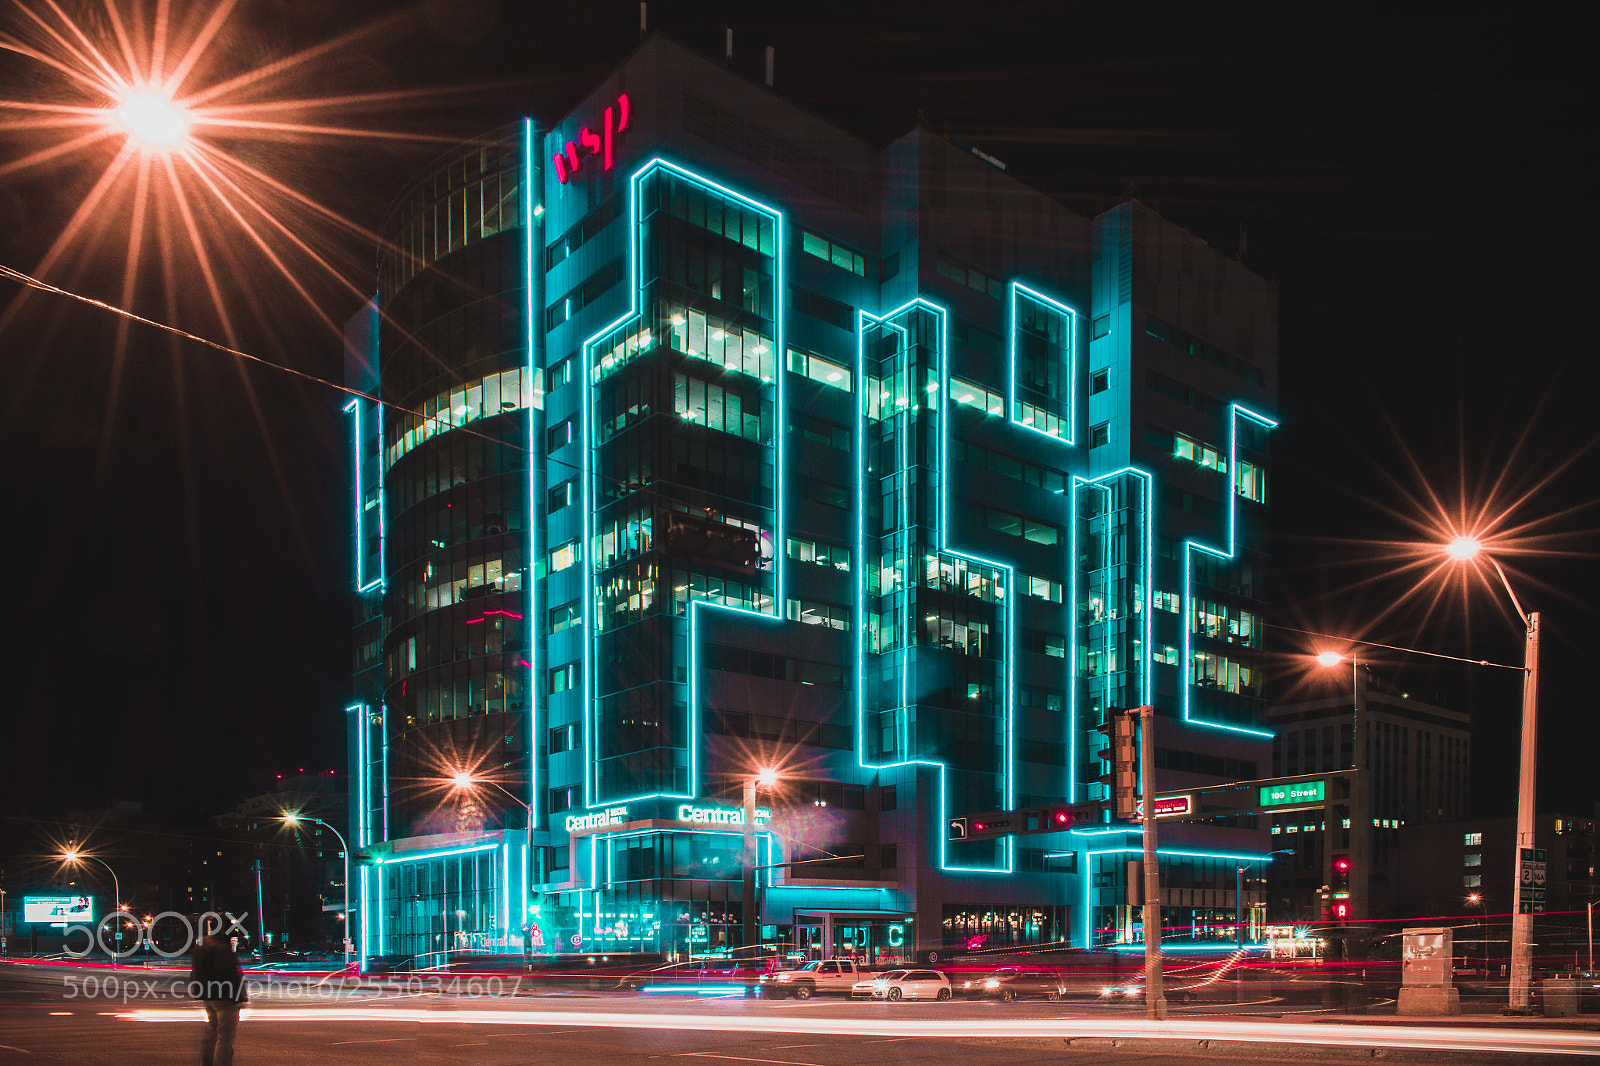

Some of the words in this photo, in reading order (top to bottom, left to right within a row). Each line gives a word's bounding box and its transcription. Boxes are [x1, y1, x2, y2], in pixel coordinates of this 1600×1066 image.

[1271, 791, 1286, 800] 109
[1290, 788, 1317, 798] Street
[566, 808, 610, 832] Central
[678, 805, 745, 825] Central
[1524, 870, 1530, 880] 2
